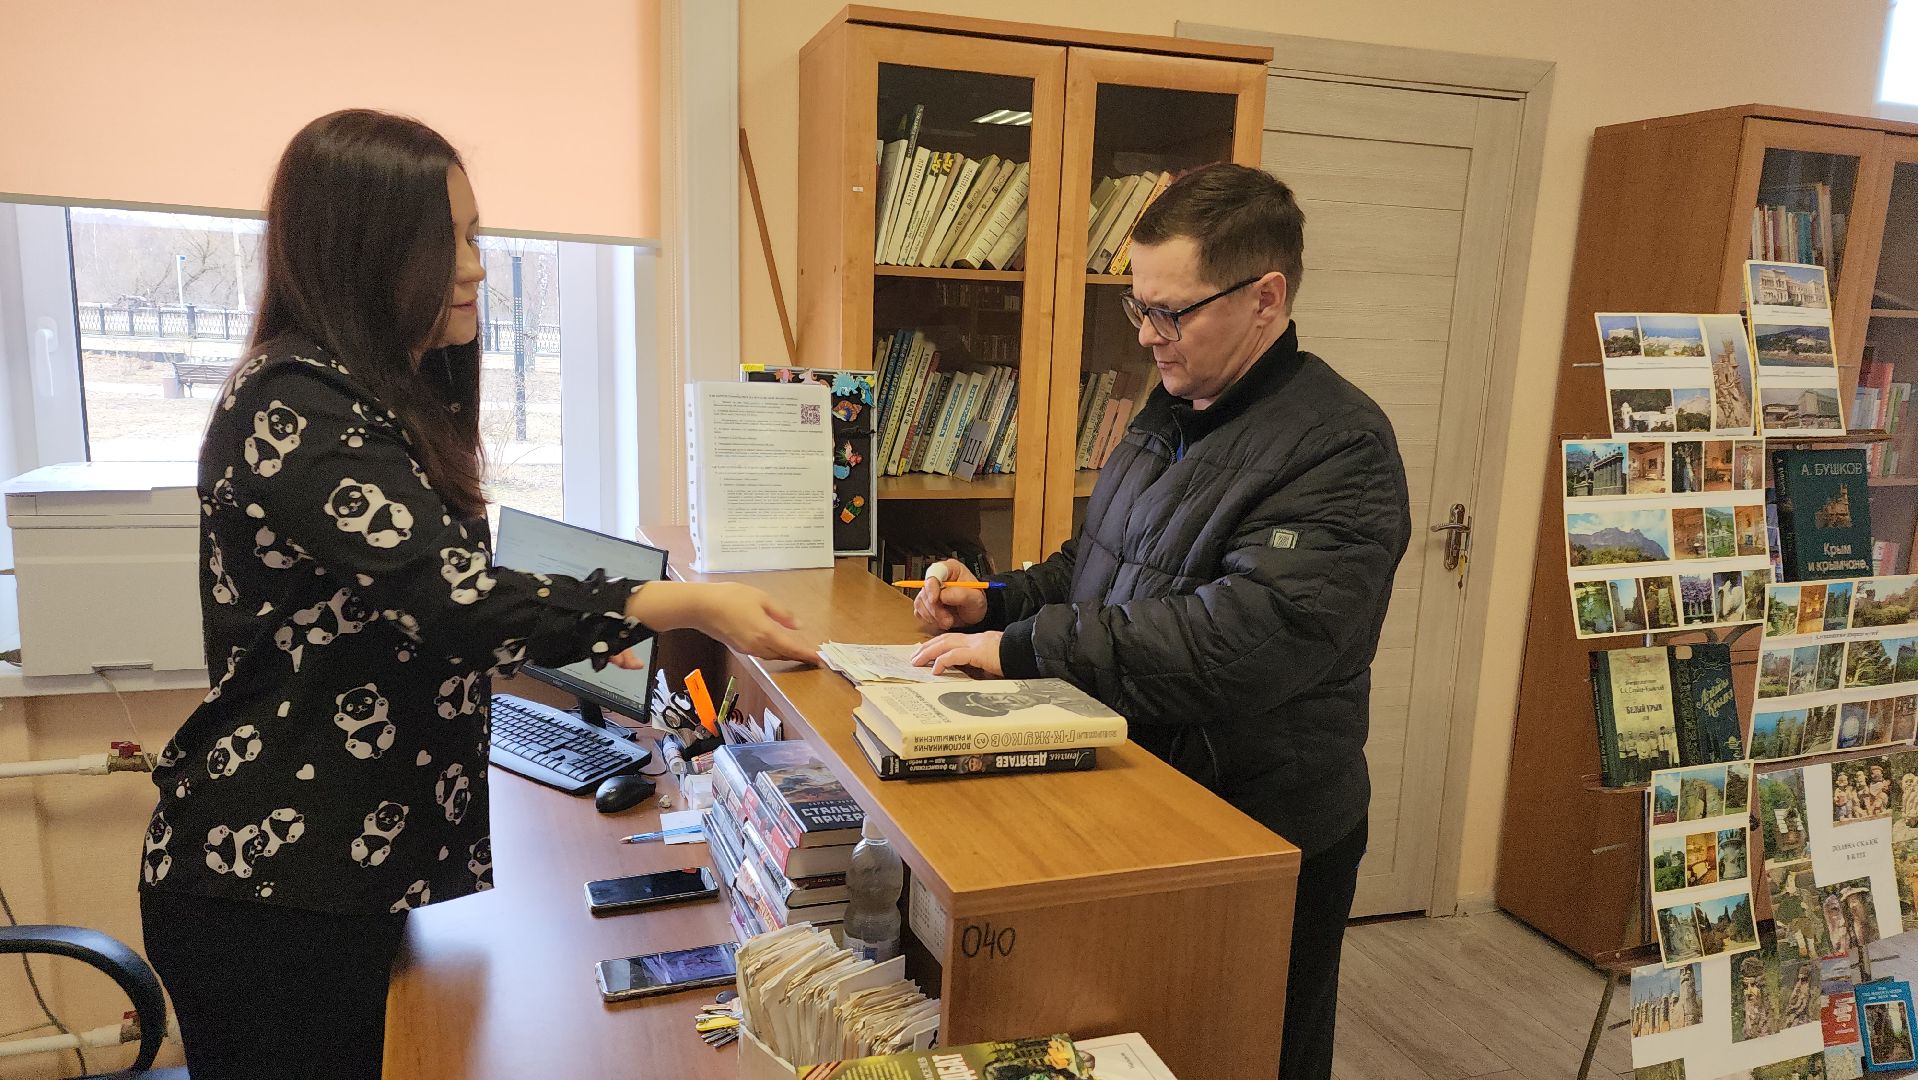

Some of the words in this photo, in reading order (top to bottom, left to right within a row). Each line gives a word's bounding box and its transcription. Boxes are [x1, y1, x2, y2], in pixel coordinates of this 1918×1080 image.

[1815, 463, 1862, 475] БУШКОВ
[1824, 543, 1852, 557] Крым
[914, 734, 965, 743] РАЗМЫШЛЕНИЯ
[914, 743, 971, 752] ВОСПОМИНАНИЯ
[995, 752, 1047, 768] ДЕВЯТАЕВ
[962, 922, 1016, 959] 040
